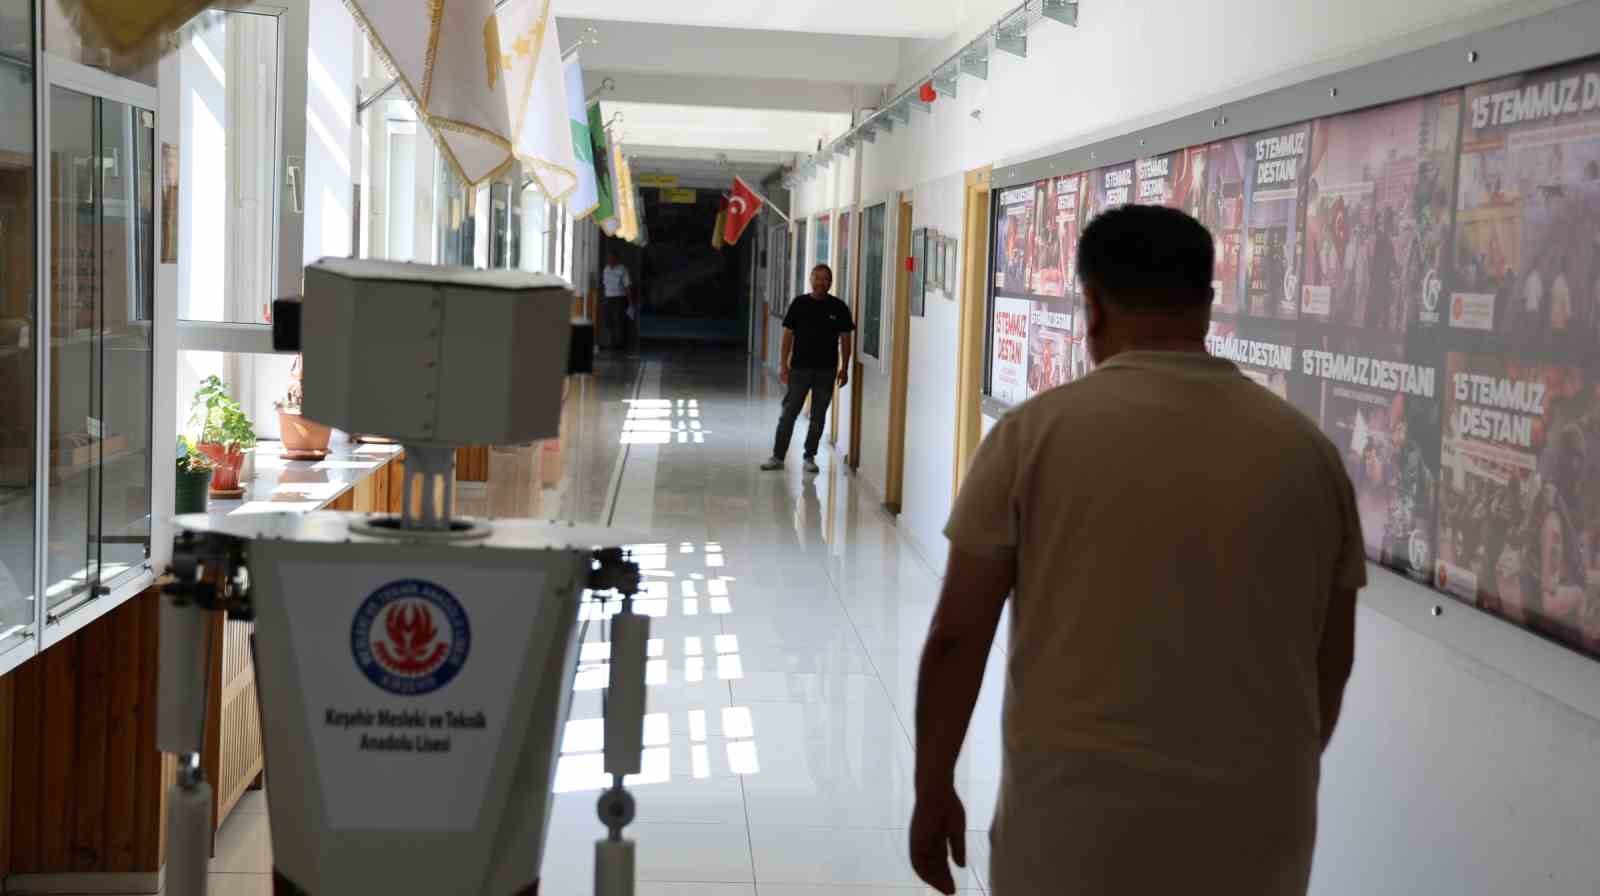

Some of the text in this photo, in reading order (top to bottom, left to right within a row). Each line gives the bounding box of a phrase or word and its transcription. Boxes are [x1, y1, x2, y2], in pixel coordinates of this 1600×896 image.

[1471, 95, 1489, 129] 15
[1490, 75, 1580, 126] TEMMUZ
[1264, 132, 1305, 160] TEMMUZ
[1257, 159, 1297, 184] DESTANI
[1210, 335, 1249, 362] TEMMUZ
[1249, 340, 1292, 371] DESTANI
[1302, 349, 1314, 376] 15
[1314, 350, 1370, 385] TEMMUZ
[1370, 359, 1435, 398] DESTANI
[1454, 373, 1545, 415] 15 TEMMUZ
[1460, 405, 1532, 448] DESTANI
[325, 708, 486, 731] Kırşehir Mesleki ve Teknik
[360, 733, 451, 752] Anadolu Lisesi
